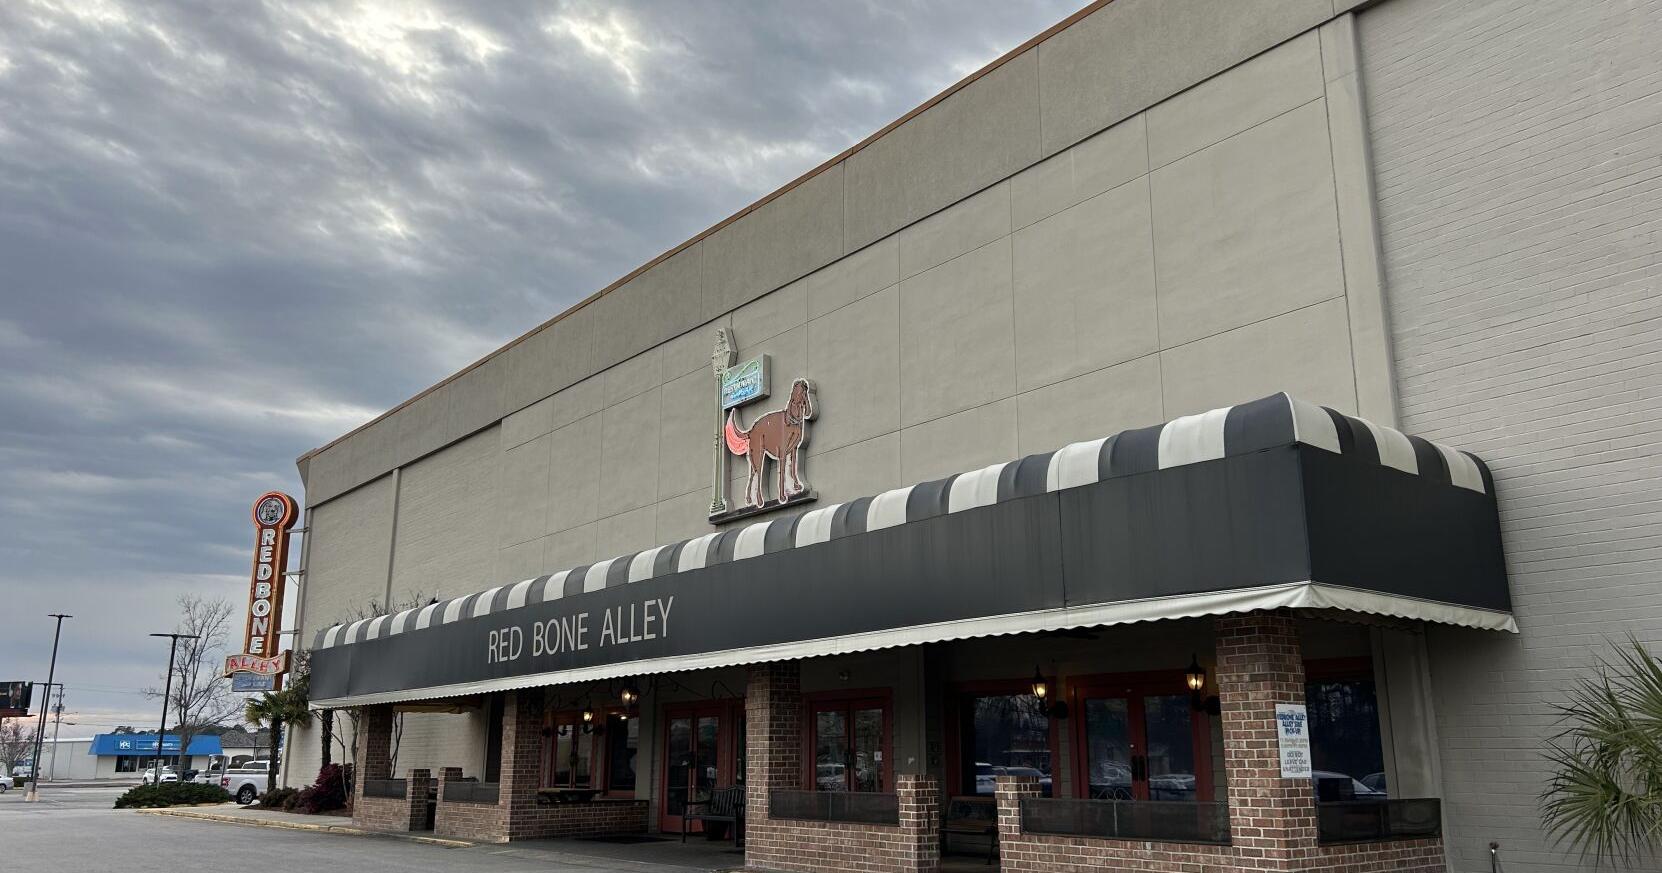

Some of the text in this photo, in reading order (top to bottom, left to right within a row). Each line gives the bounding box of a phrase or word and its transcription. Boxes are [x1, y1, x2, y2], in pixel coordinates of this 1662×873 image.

[488, 596, 674, 664] RED BONE ALLEY
